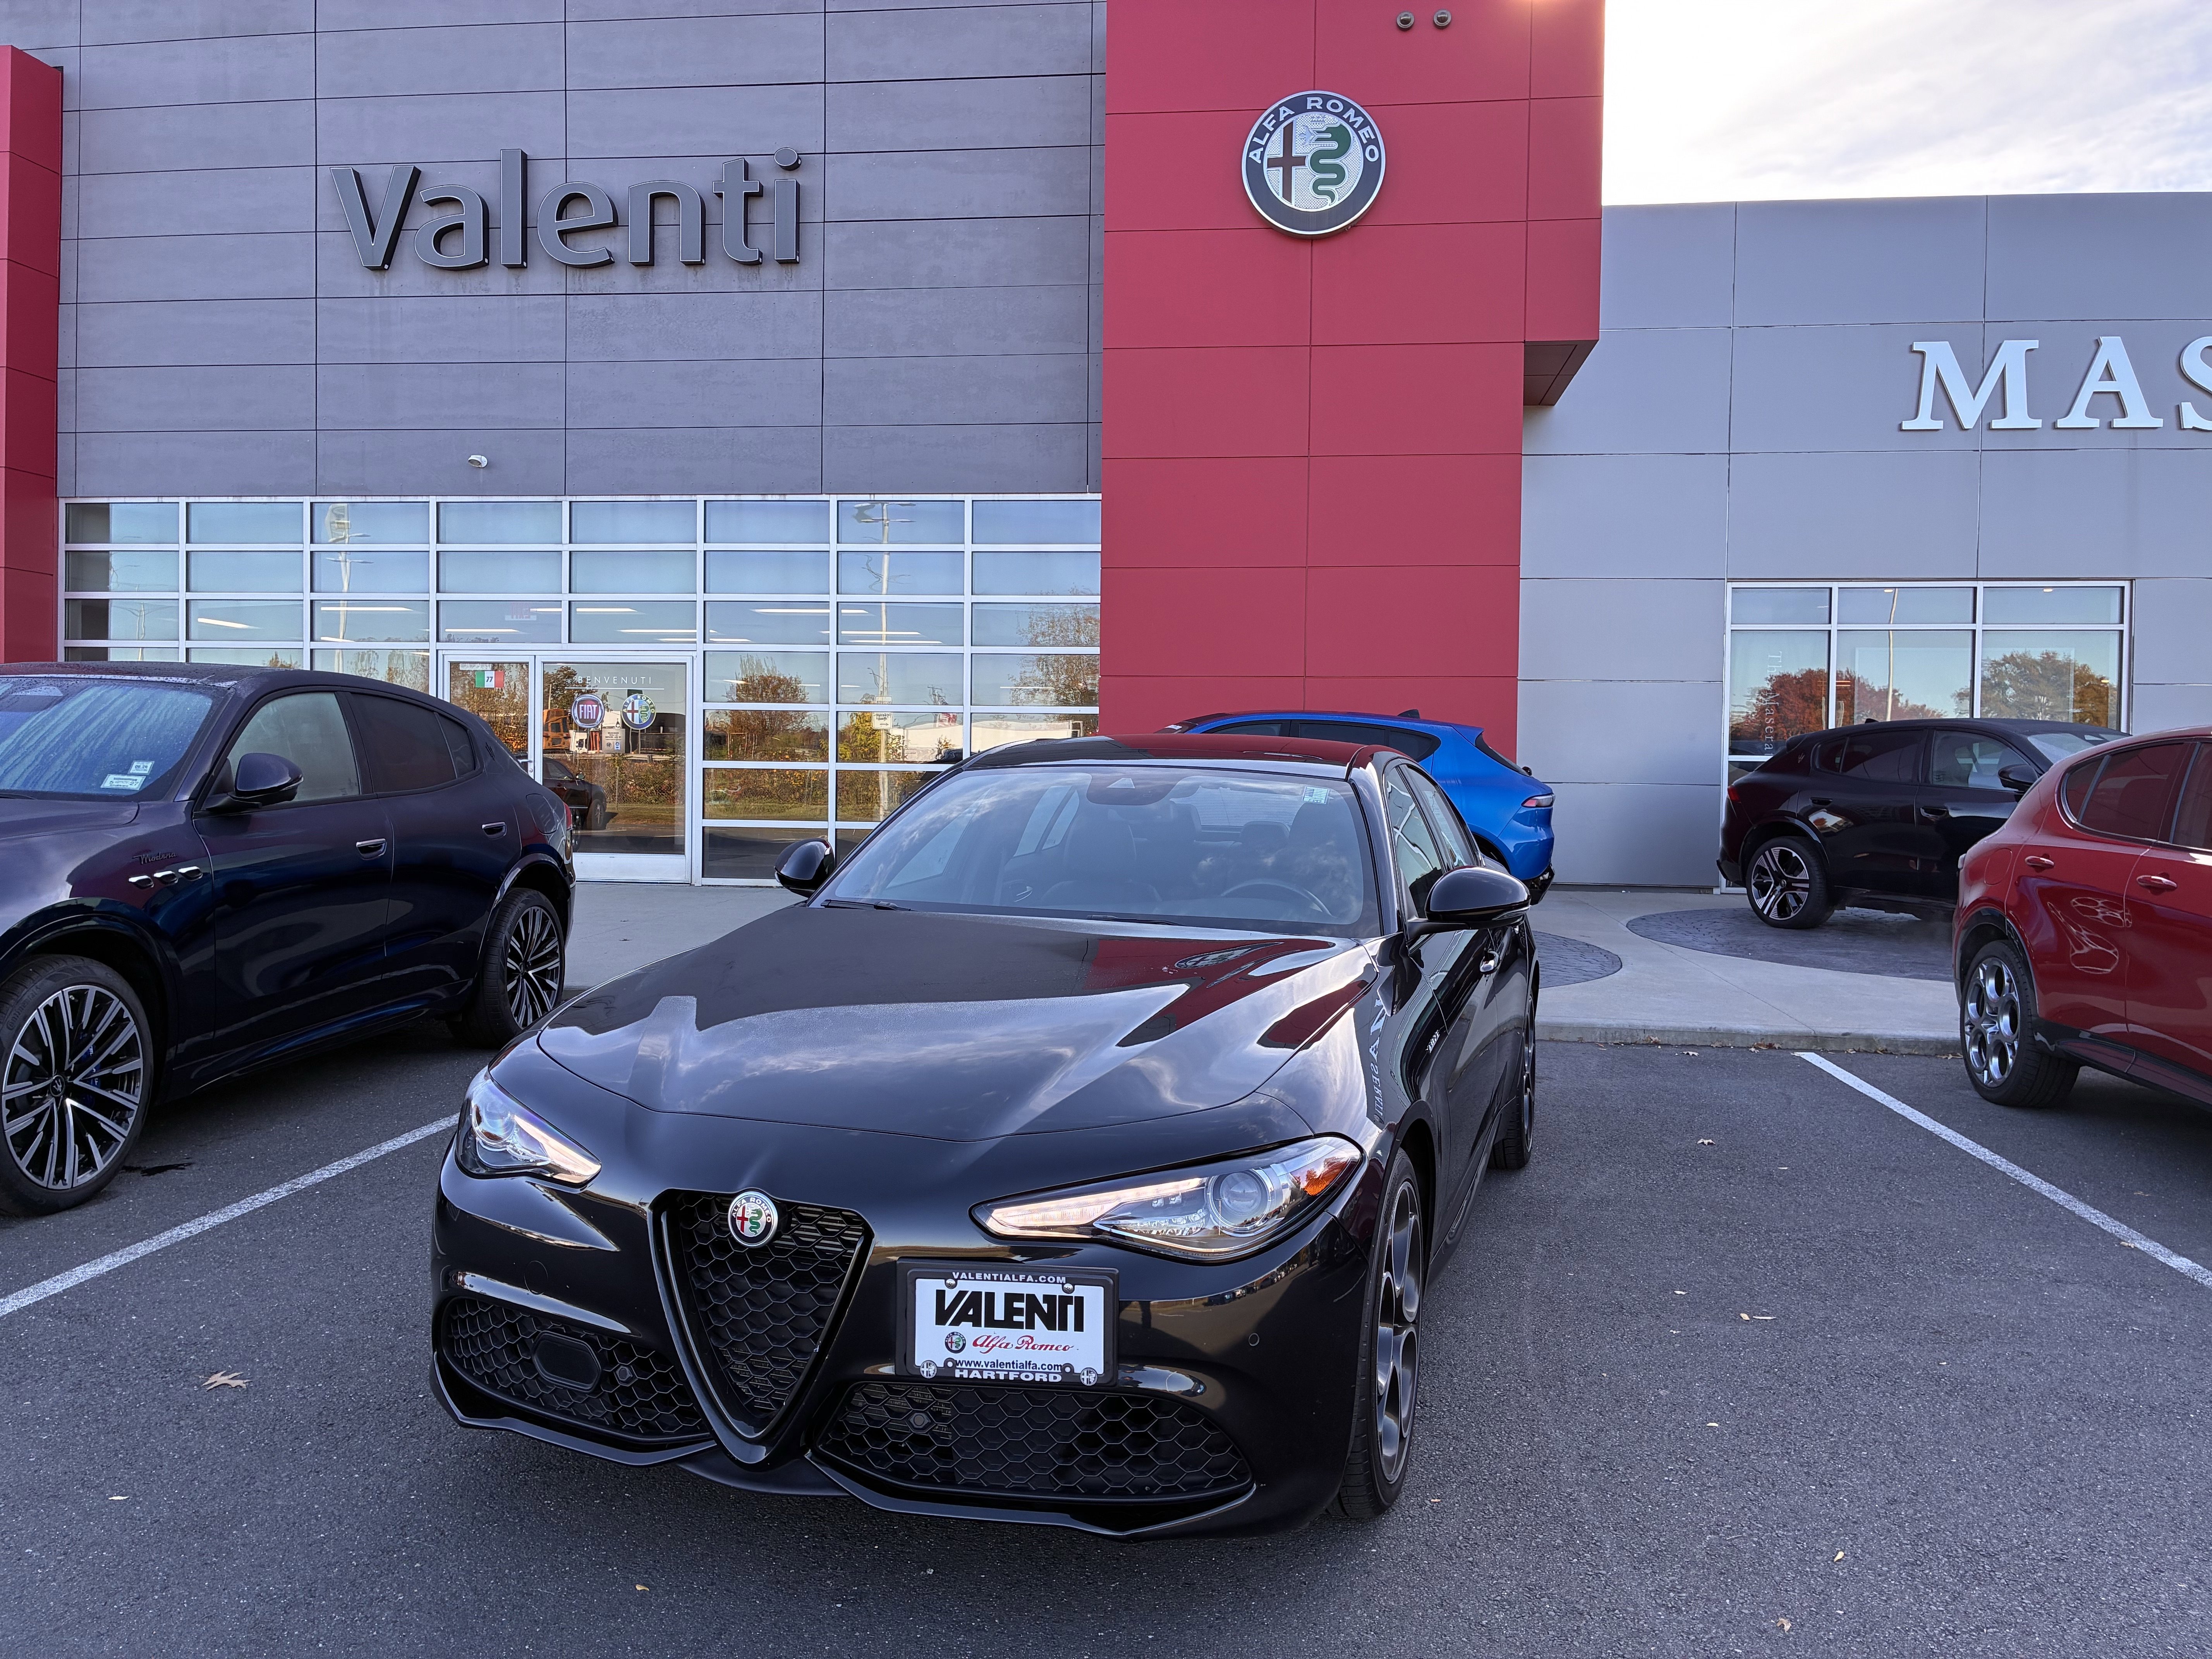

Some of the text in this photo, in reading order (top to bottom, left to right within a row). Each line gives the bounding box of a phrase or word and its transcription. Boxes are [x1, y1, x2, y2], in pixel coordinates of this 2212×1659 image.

[1249, 97, 1379, 163] ALFA ROMEO
[330, 147, 802, 270] Valenti
[578, 676, 651, 684] BENVENUTI
[579, 704, 597, 719] FIAT
[623, 695, 655, 713] ALFA ROMEO
[132, 852, 177, 864] Modena
[732, 1197, 771, 1223] ALFA ROMEO
[952, 1272, 1066, 1283] VALENTIALFA.COM
[935, 1289, 1084, 1332] VALENTI
[972, 1335, 1074, 1354] Alfa Romeo
[955, 1359, 1062, 1371] www.valentialfa.com
[955, 1369, 1062, 1382] HARTFORD
